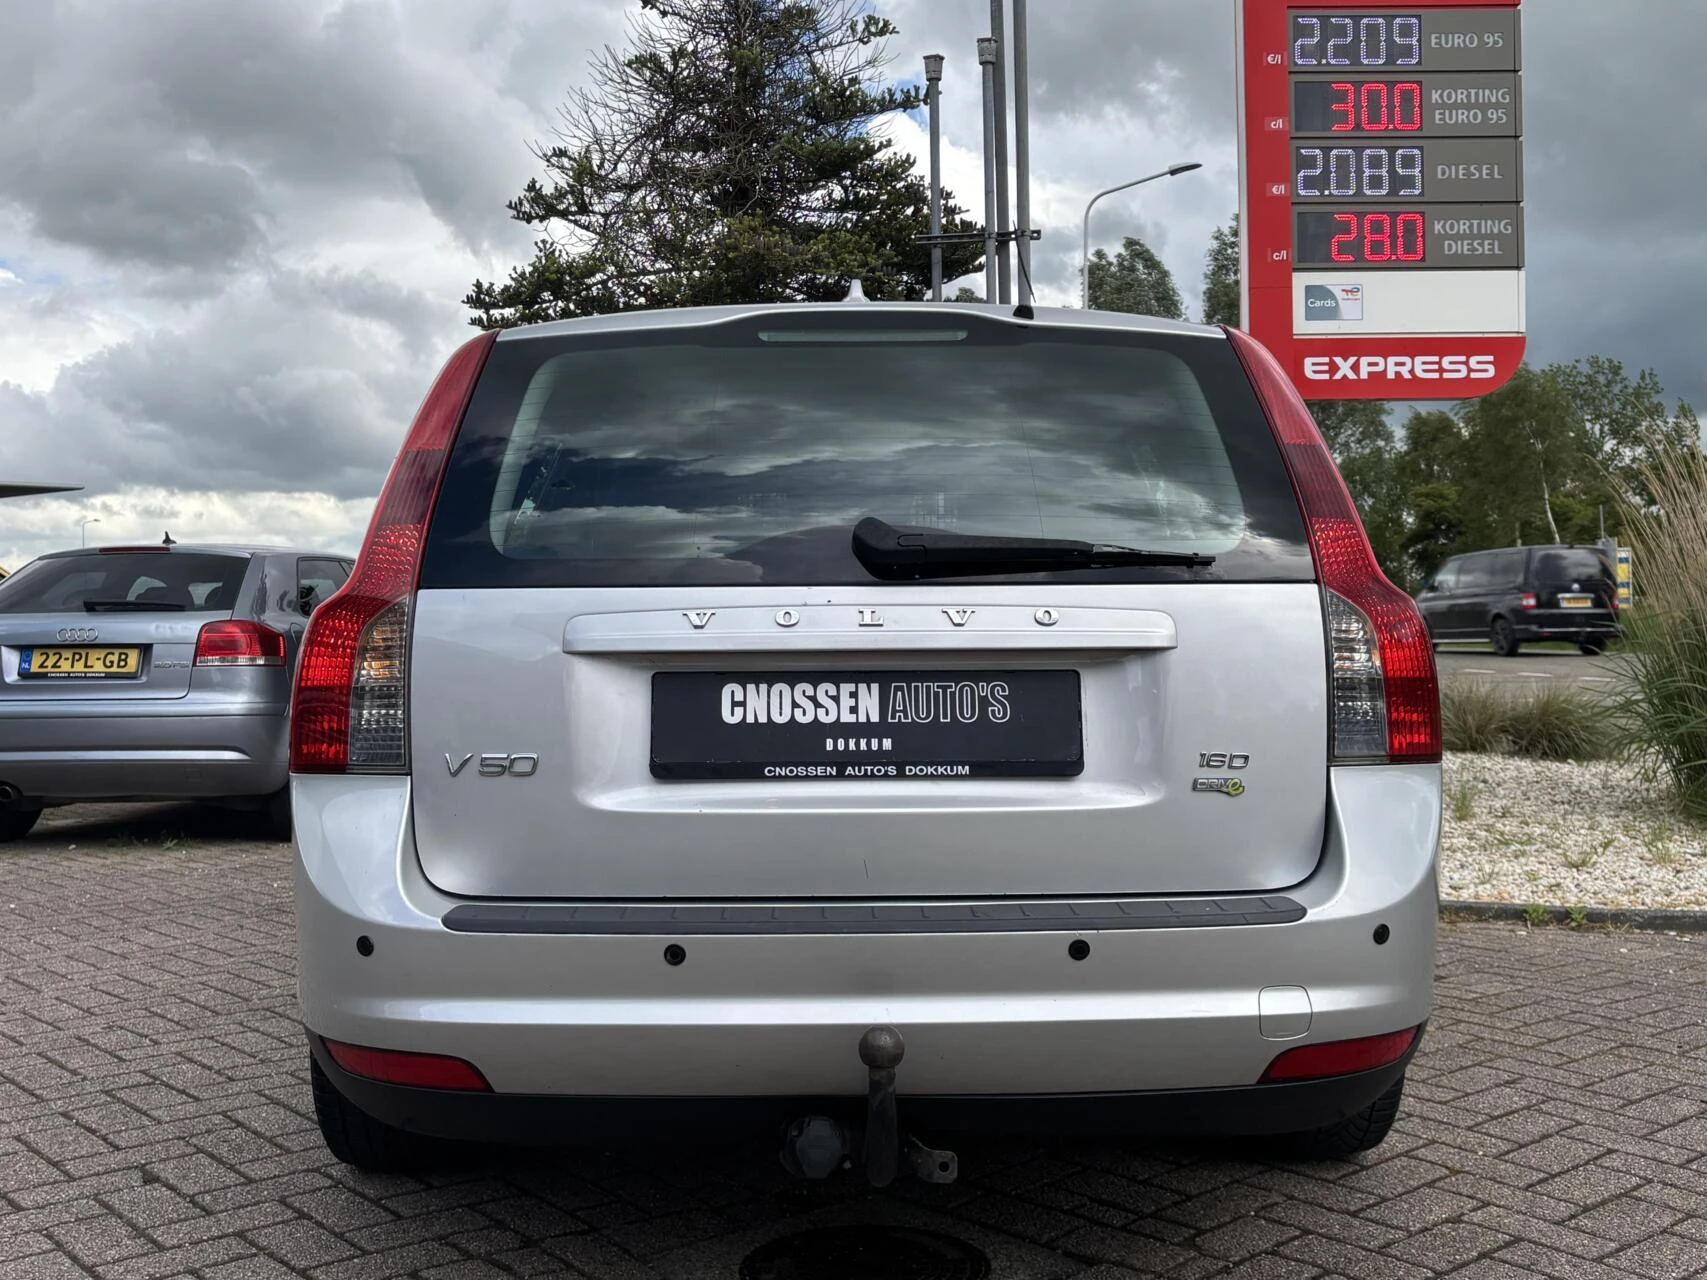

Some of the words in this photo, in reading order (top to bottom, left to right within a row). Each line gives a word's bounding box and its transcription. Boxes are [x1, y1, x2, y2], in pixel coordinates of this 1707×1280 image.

[1294, 17, 1420, 65] 2.209
[1431, 33, 1478, 48] EURO
[1483, 33, 1504, 48] 95
[1431, 88, 1510, 104] KORTING
[1331, 83, 1421, 131] 30.0
[1434, 109, 1482, 124] EURO
[1487, 109, 1507, 124] 95
[1297, 149, 1422, 196] 2.089
[1437, 164, 1503, 179] DIESEL
[1434, 219, 1512, 234] KORTING
[1331, 214, 1424, 262] 28.0
[1444, 240, 1503, 255] DIESEL
[1307, 298, 1337, 308] Cards
[1303, 355, 1496, 380] EXPRESS
[682, 607, 1060, 630] VOLVO
[21, 661, 30, 669] NL
[38, 651, 129, 669] 22-PL-GB
[721, 682, 880, 725] CNOSSEN
[888, 681, 1011, 724] AUTO'S
[825, 737, 893, 752] DOKKUM
[444, 753, 539, 778] V50
[764, 765, 837, 777] CNOSSEN
[844, 765, 897, 777] AUTO'S
[905, 764, 970, 777] DOKKUM
